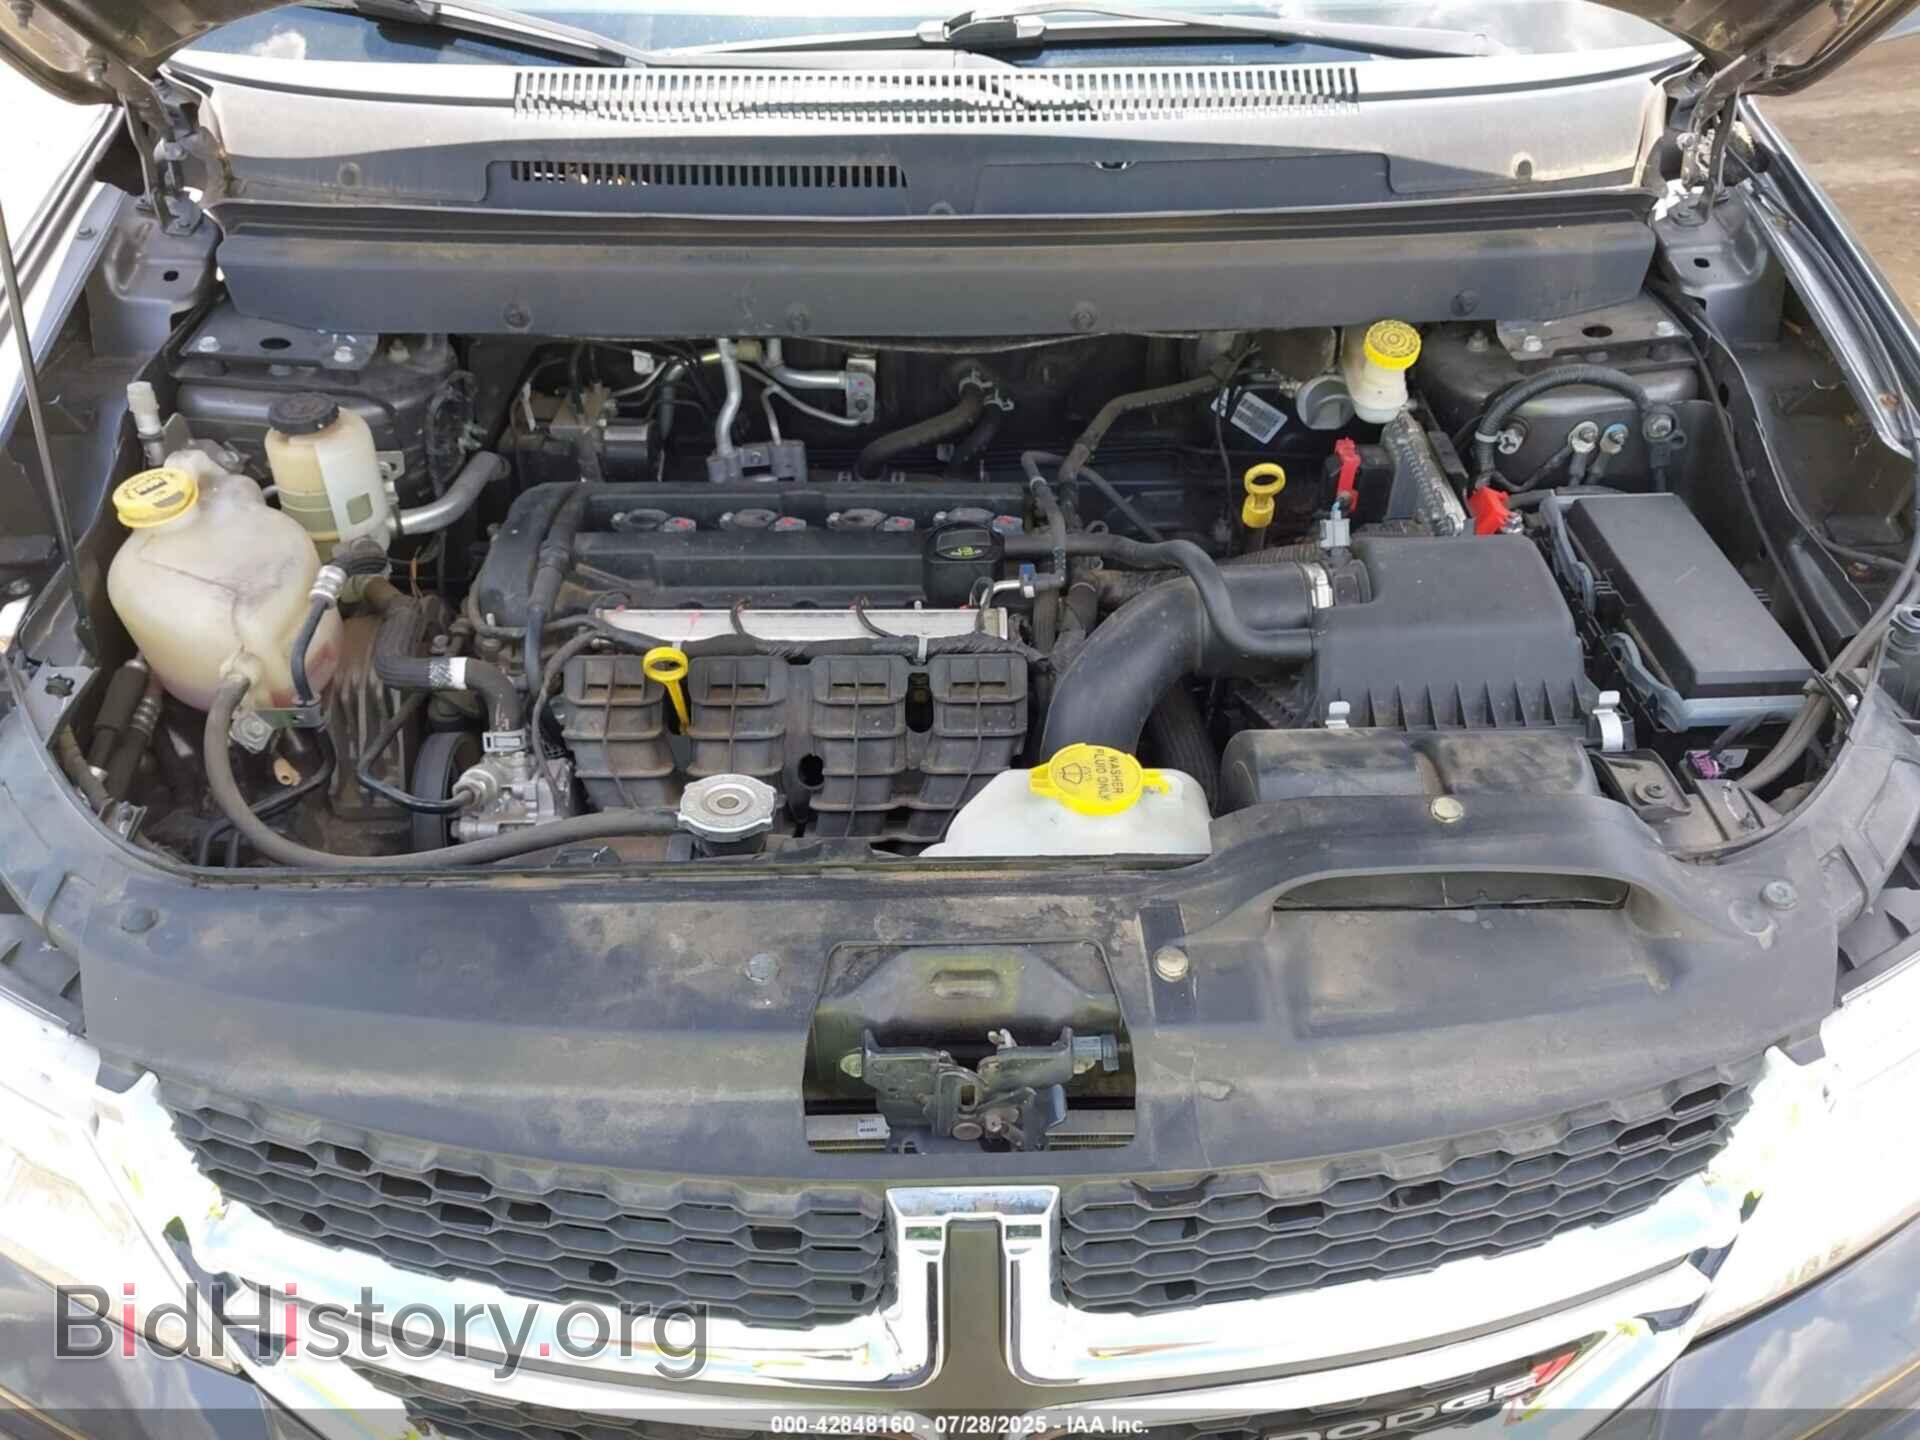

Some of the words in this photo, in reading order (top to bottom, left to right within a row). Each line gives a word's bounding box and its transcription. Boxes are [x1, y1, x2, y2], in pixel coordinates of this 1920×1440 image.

[1094, 748, 1107, 776] FLUID
[1109, 755, 1124, 794] WASHER
[1096, 776, 1112, 802] ONLY
